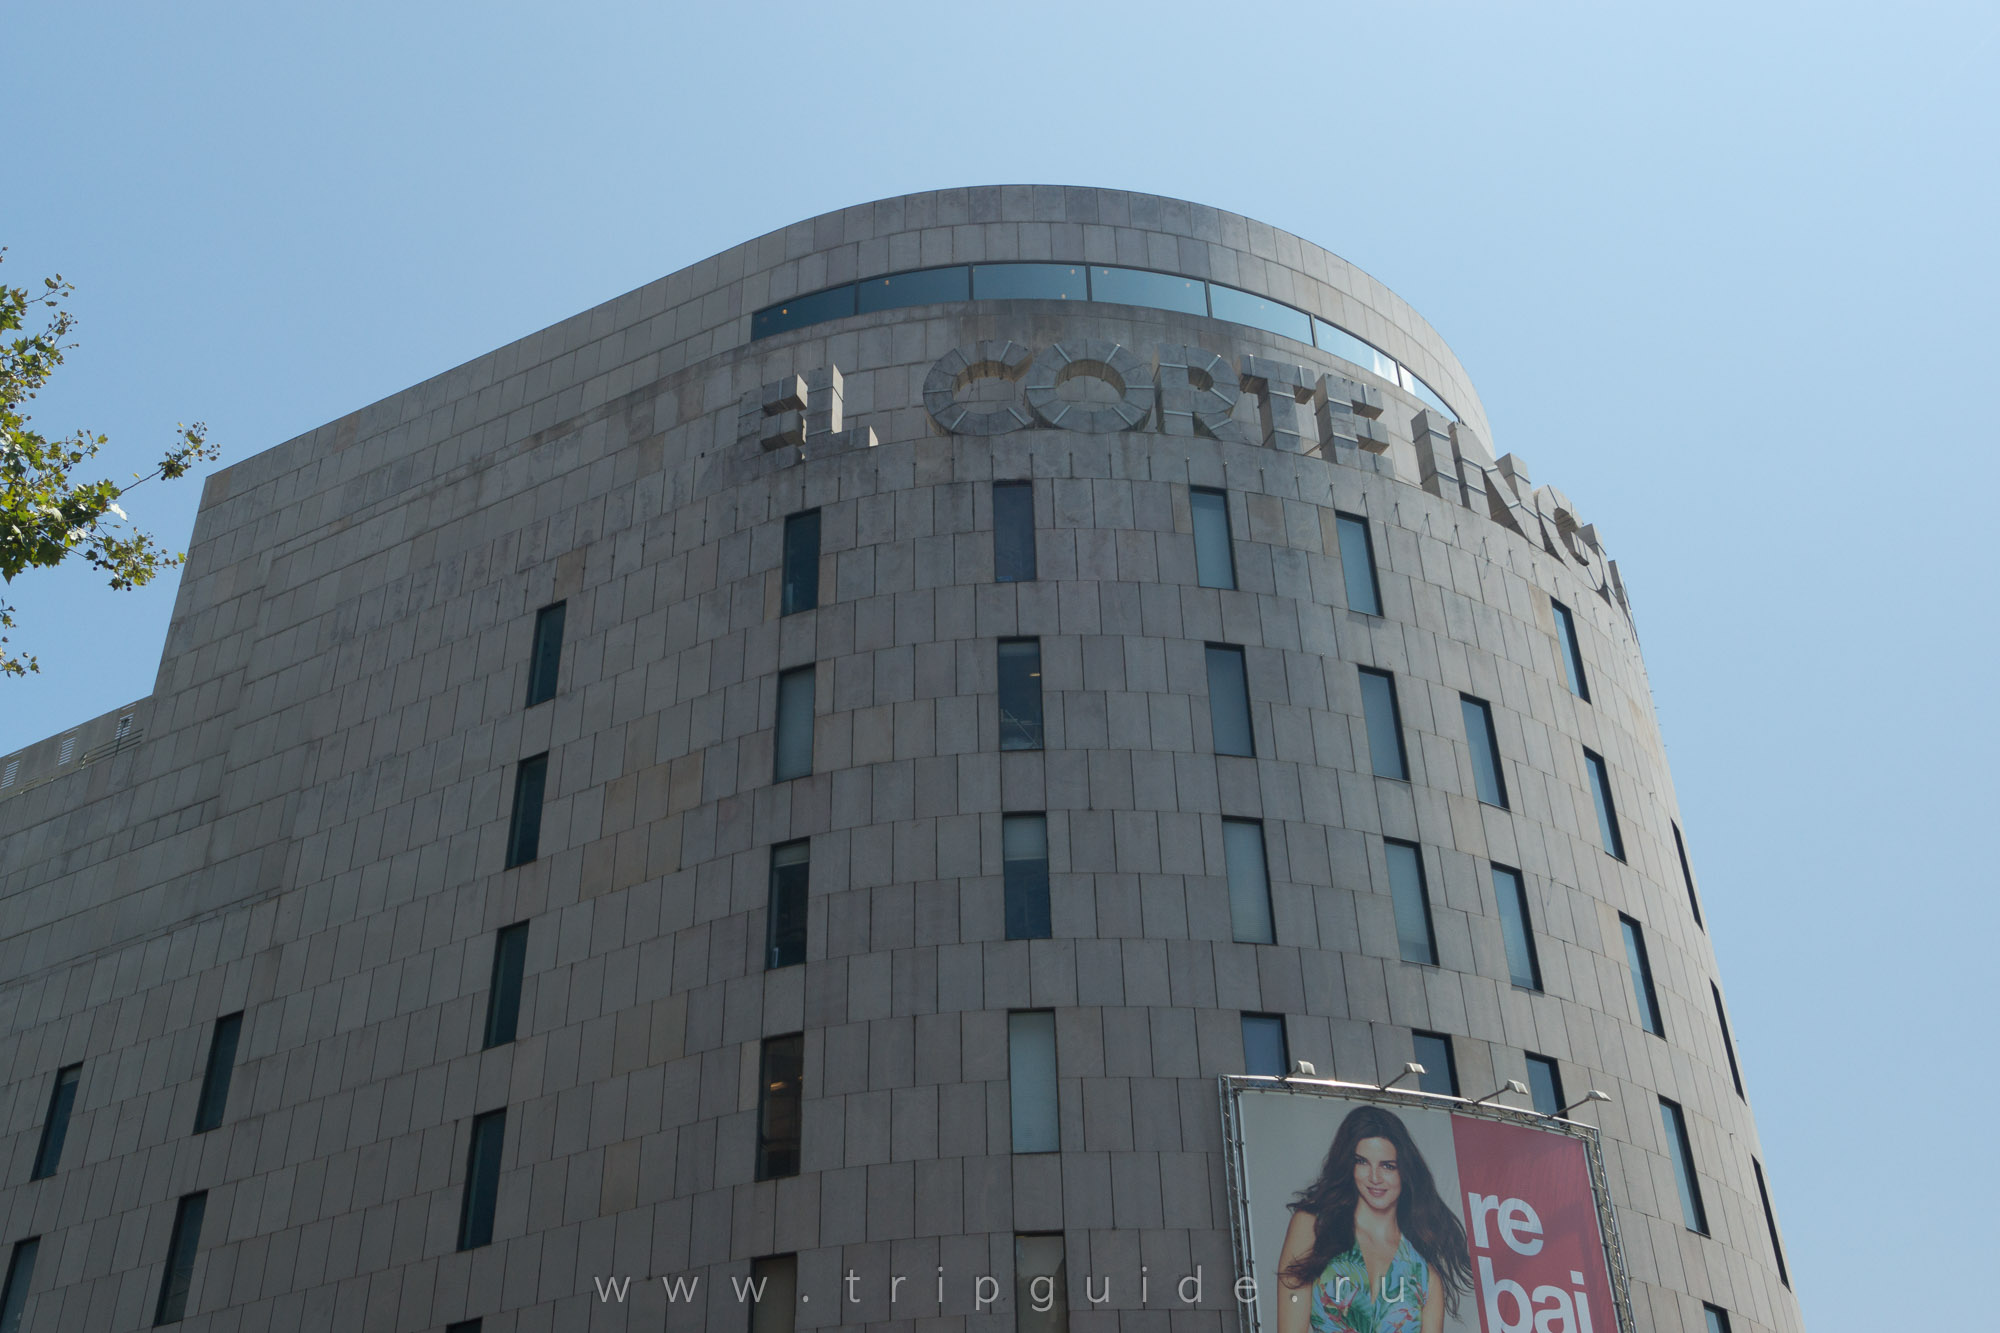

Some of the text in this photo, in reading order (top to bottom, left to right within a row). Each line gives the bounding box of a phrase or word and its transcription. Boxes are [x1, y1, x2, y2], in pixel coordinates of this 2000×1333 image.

[738, 363, 879, 466] EL
[922, 338, 1396, 480] CORTE
[1468, 1191, 1544, 1256] re
